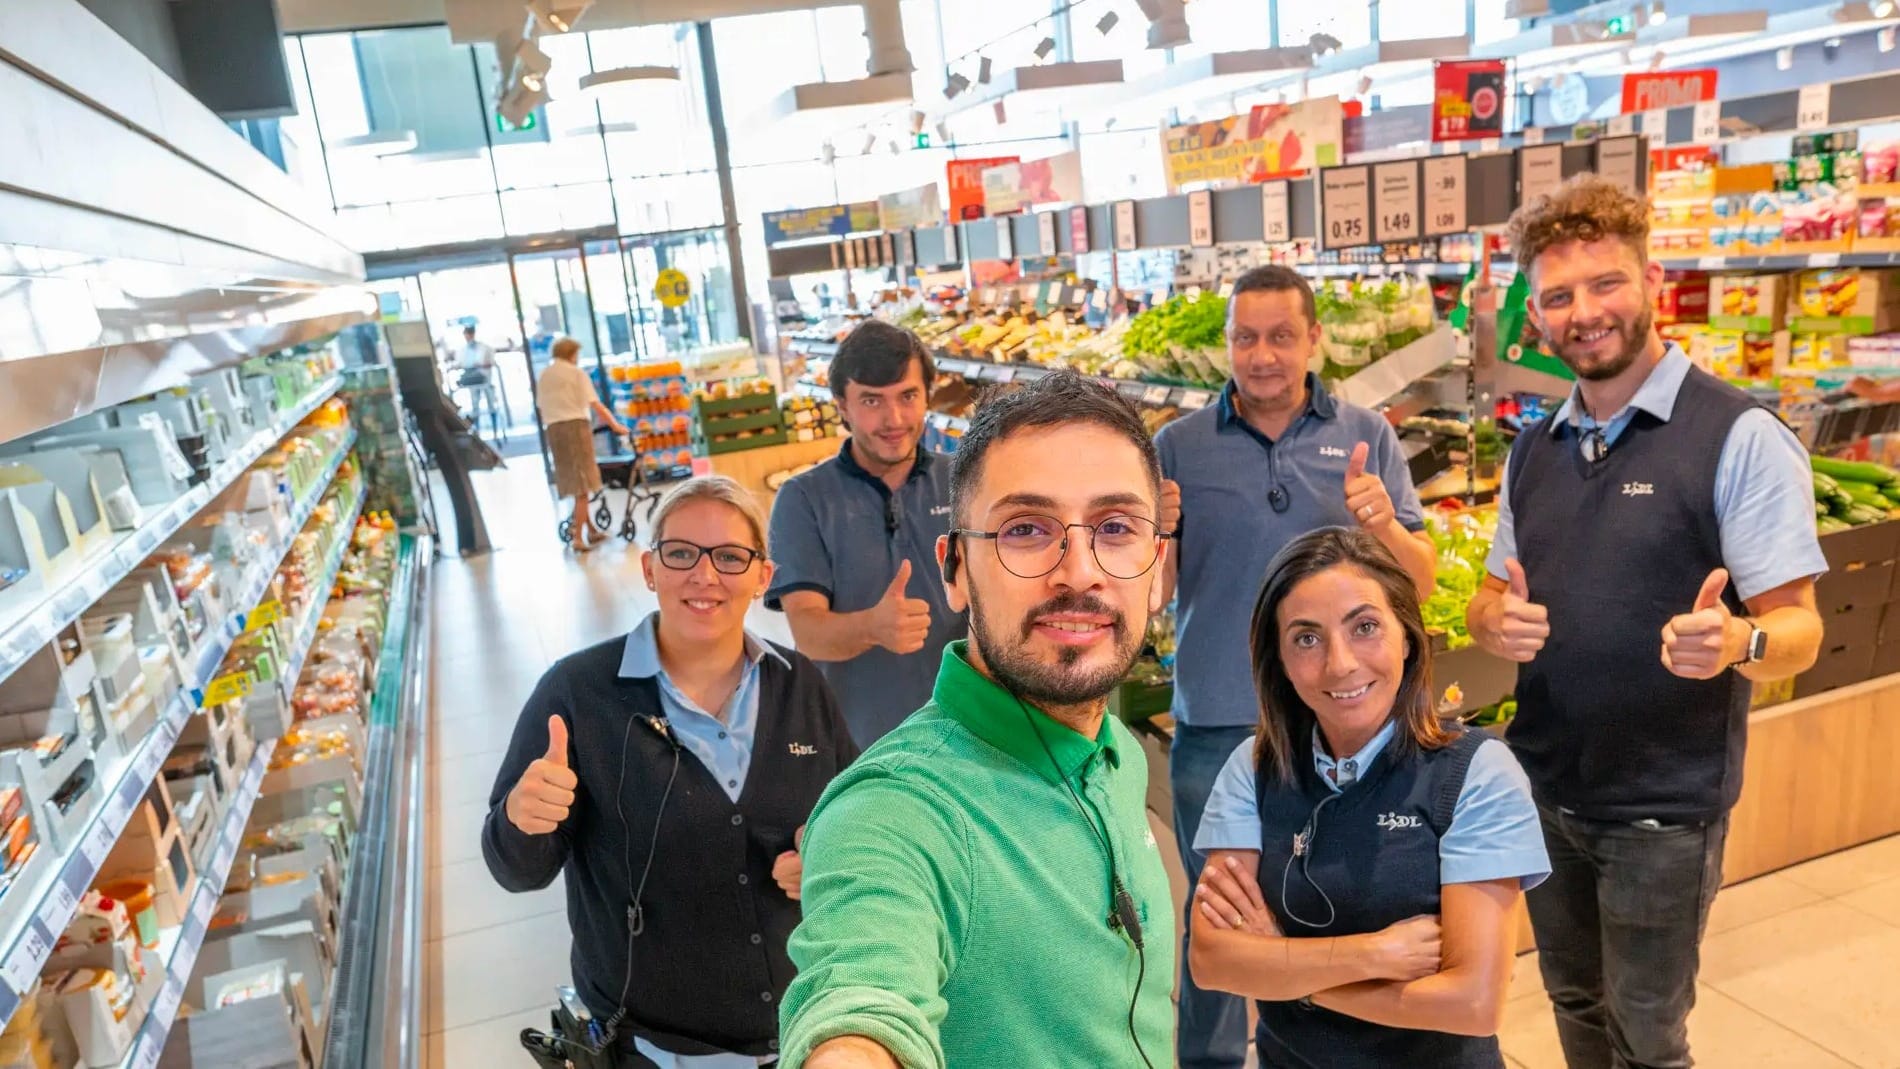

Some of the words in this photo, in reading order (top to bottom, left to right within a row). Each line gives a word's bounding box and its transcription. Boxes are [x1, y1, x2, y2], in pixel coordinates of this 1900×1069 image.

[1635, 76, 1703, 112] PROMO
[1332, 218, 1361, 239] 0.75
[1384, 213, 1410, 232] 1.49
